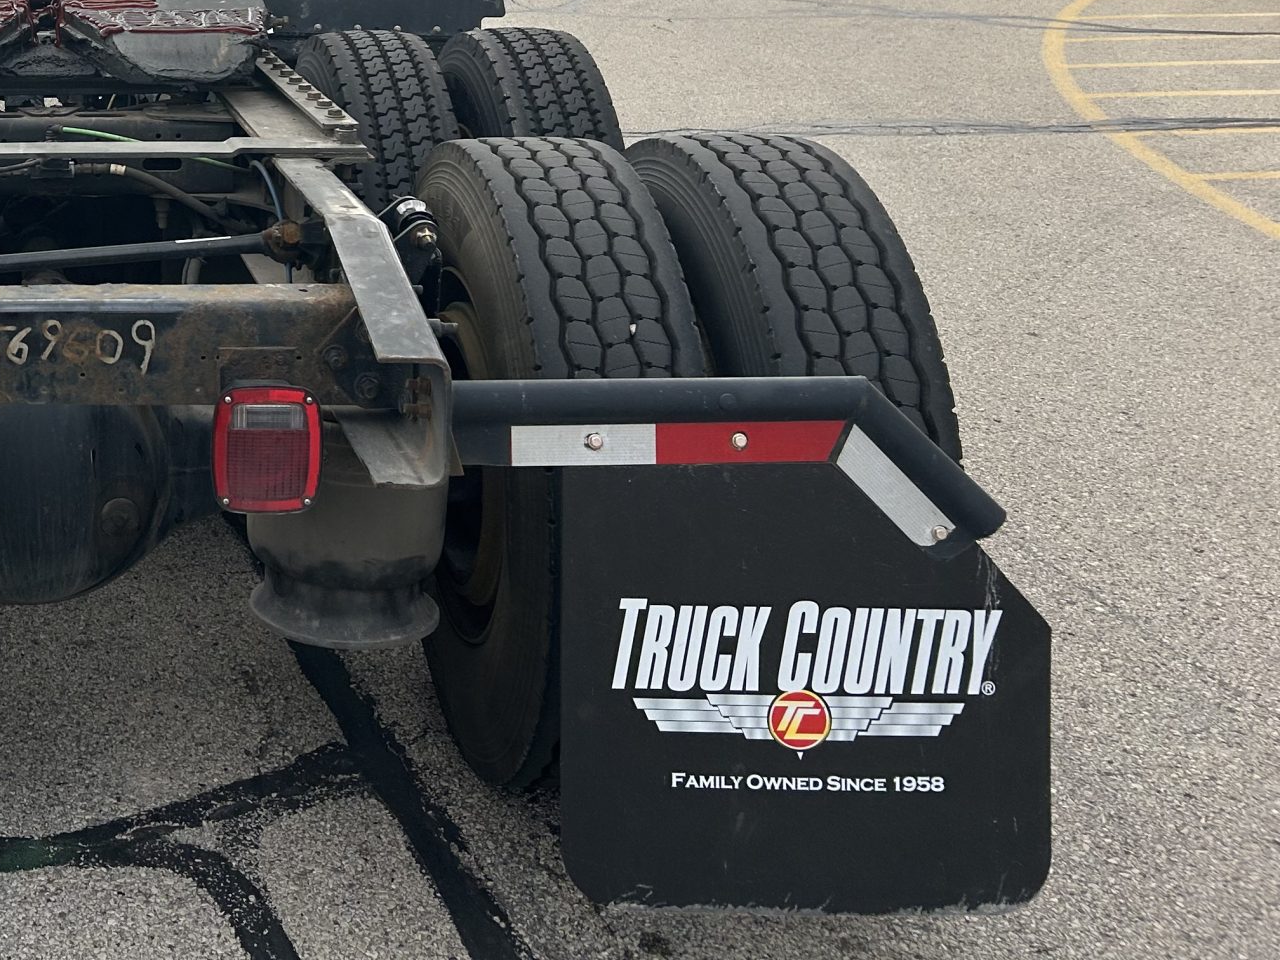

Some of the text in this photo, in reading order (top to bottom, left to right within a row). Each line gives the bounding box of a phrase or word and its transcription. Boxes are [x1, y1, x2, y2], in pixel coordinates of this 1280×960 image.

[611, 597, 1003, 696] TRUCK COUNTRY
[671, 772, 945, 793] FAMILY OWNED SINCE 1958
